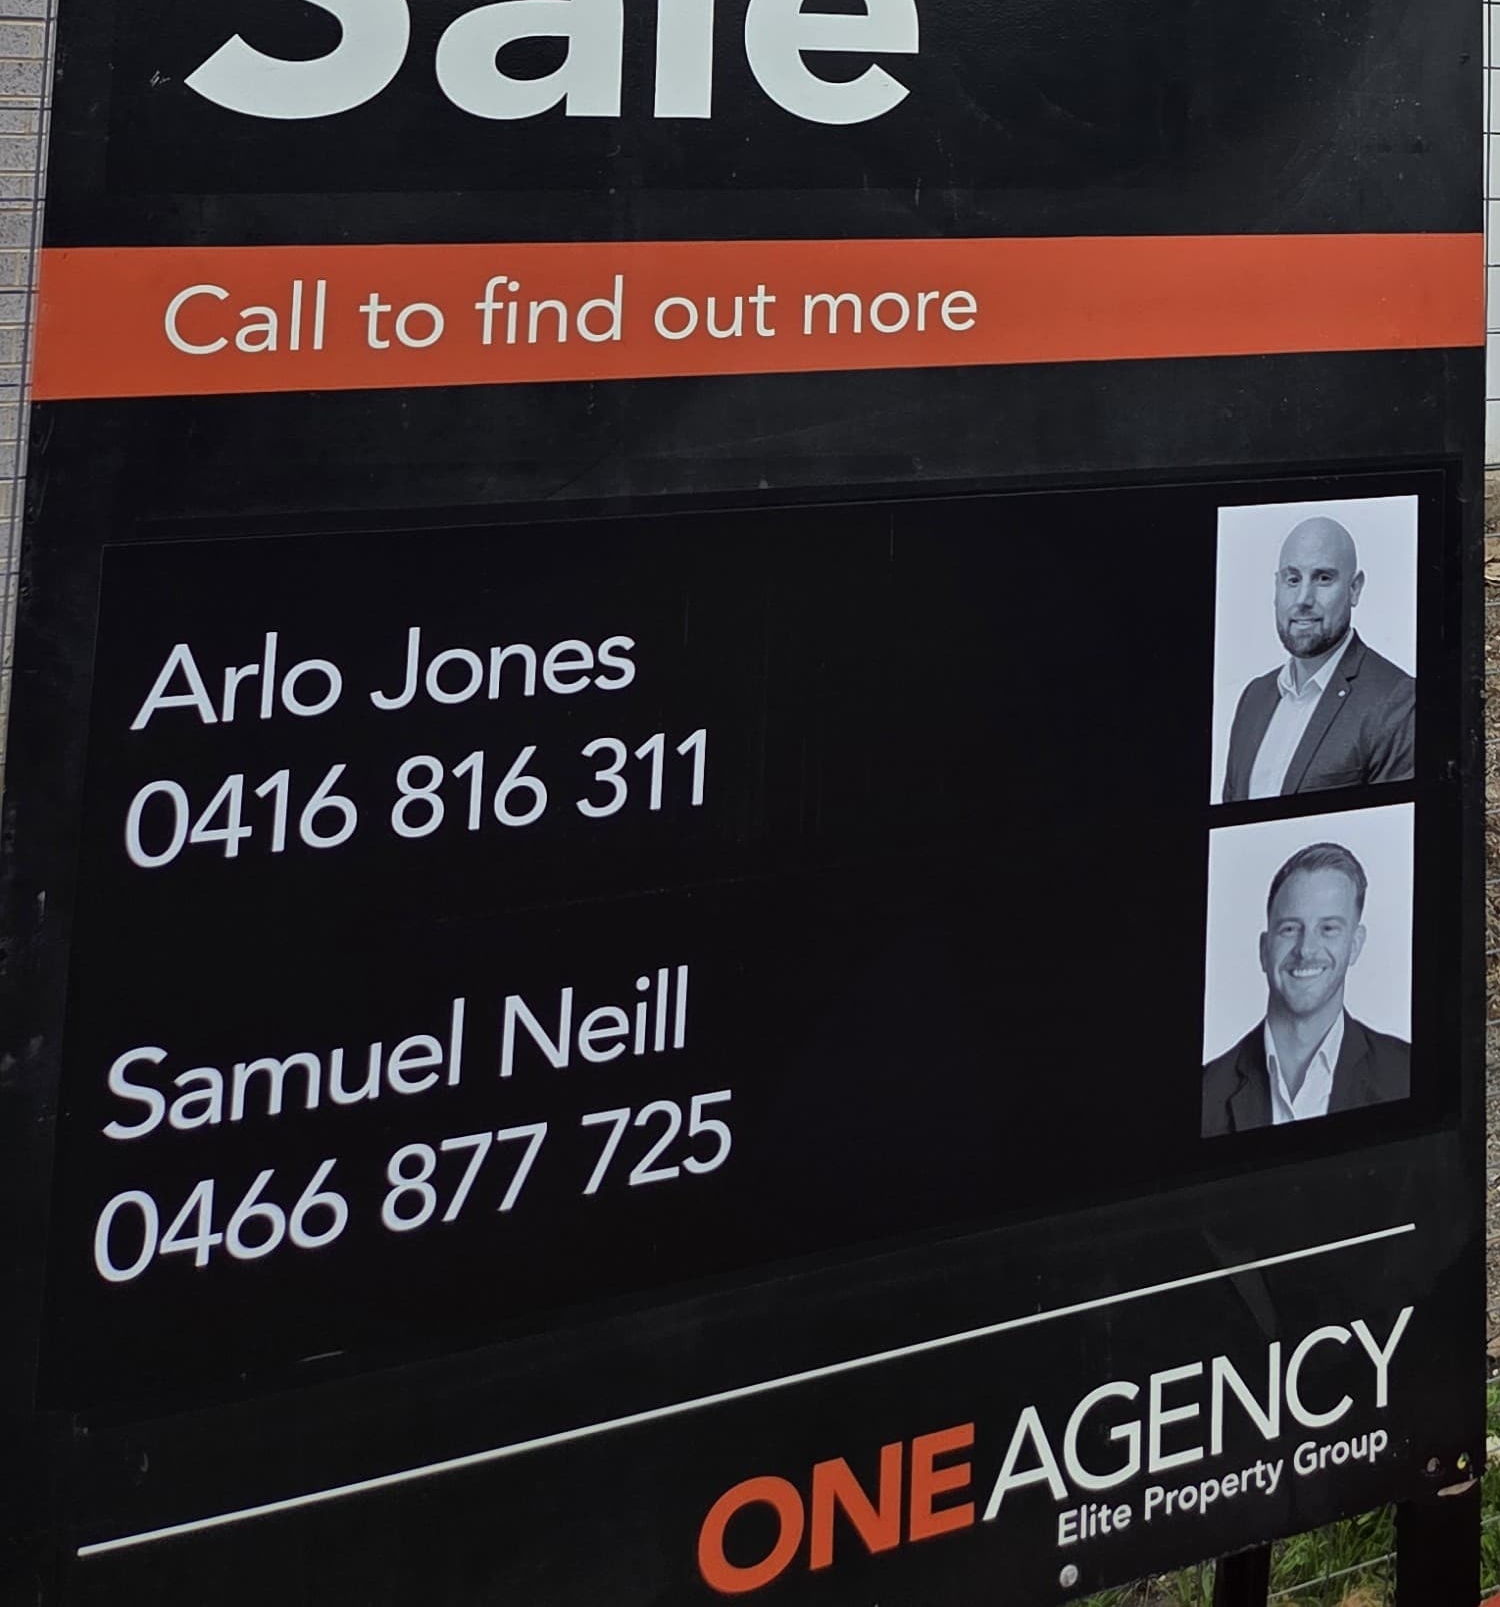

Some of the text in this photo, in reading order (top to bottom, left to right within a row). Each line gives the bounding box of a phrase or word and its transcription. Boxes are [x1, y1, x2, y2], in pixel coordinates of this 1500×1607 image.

[165, 275, 977, 355] Call to find out more
[131, 627, 636, 731] Arlo Jones
[125, 729, 707, 868] 0416 816 311
[102, 965, 689, 1139] Samuel Neill
[94, 1090, 732, 1282] 0466 877 725
[1057, 1428, 1388, 1546] Elite Property Group
